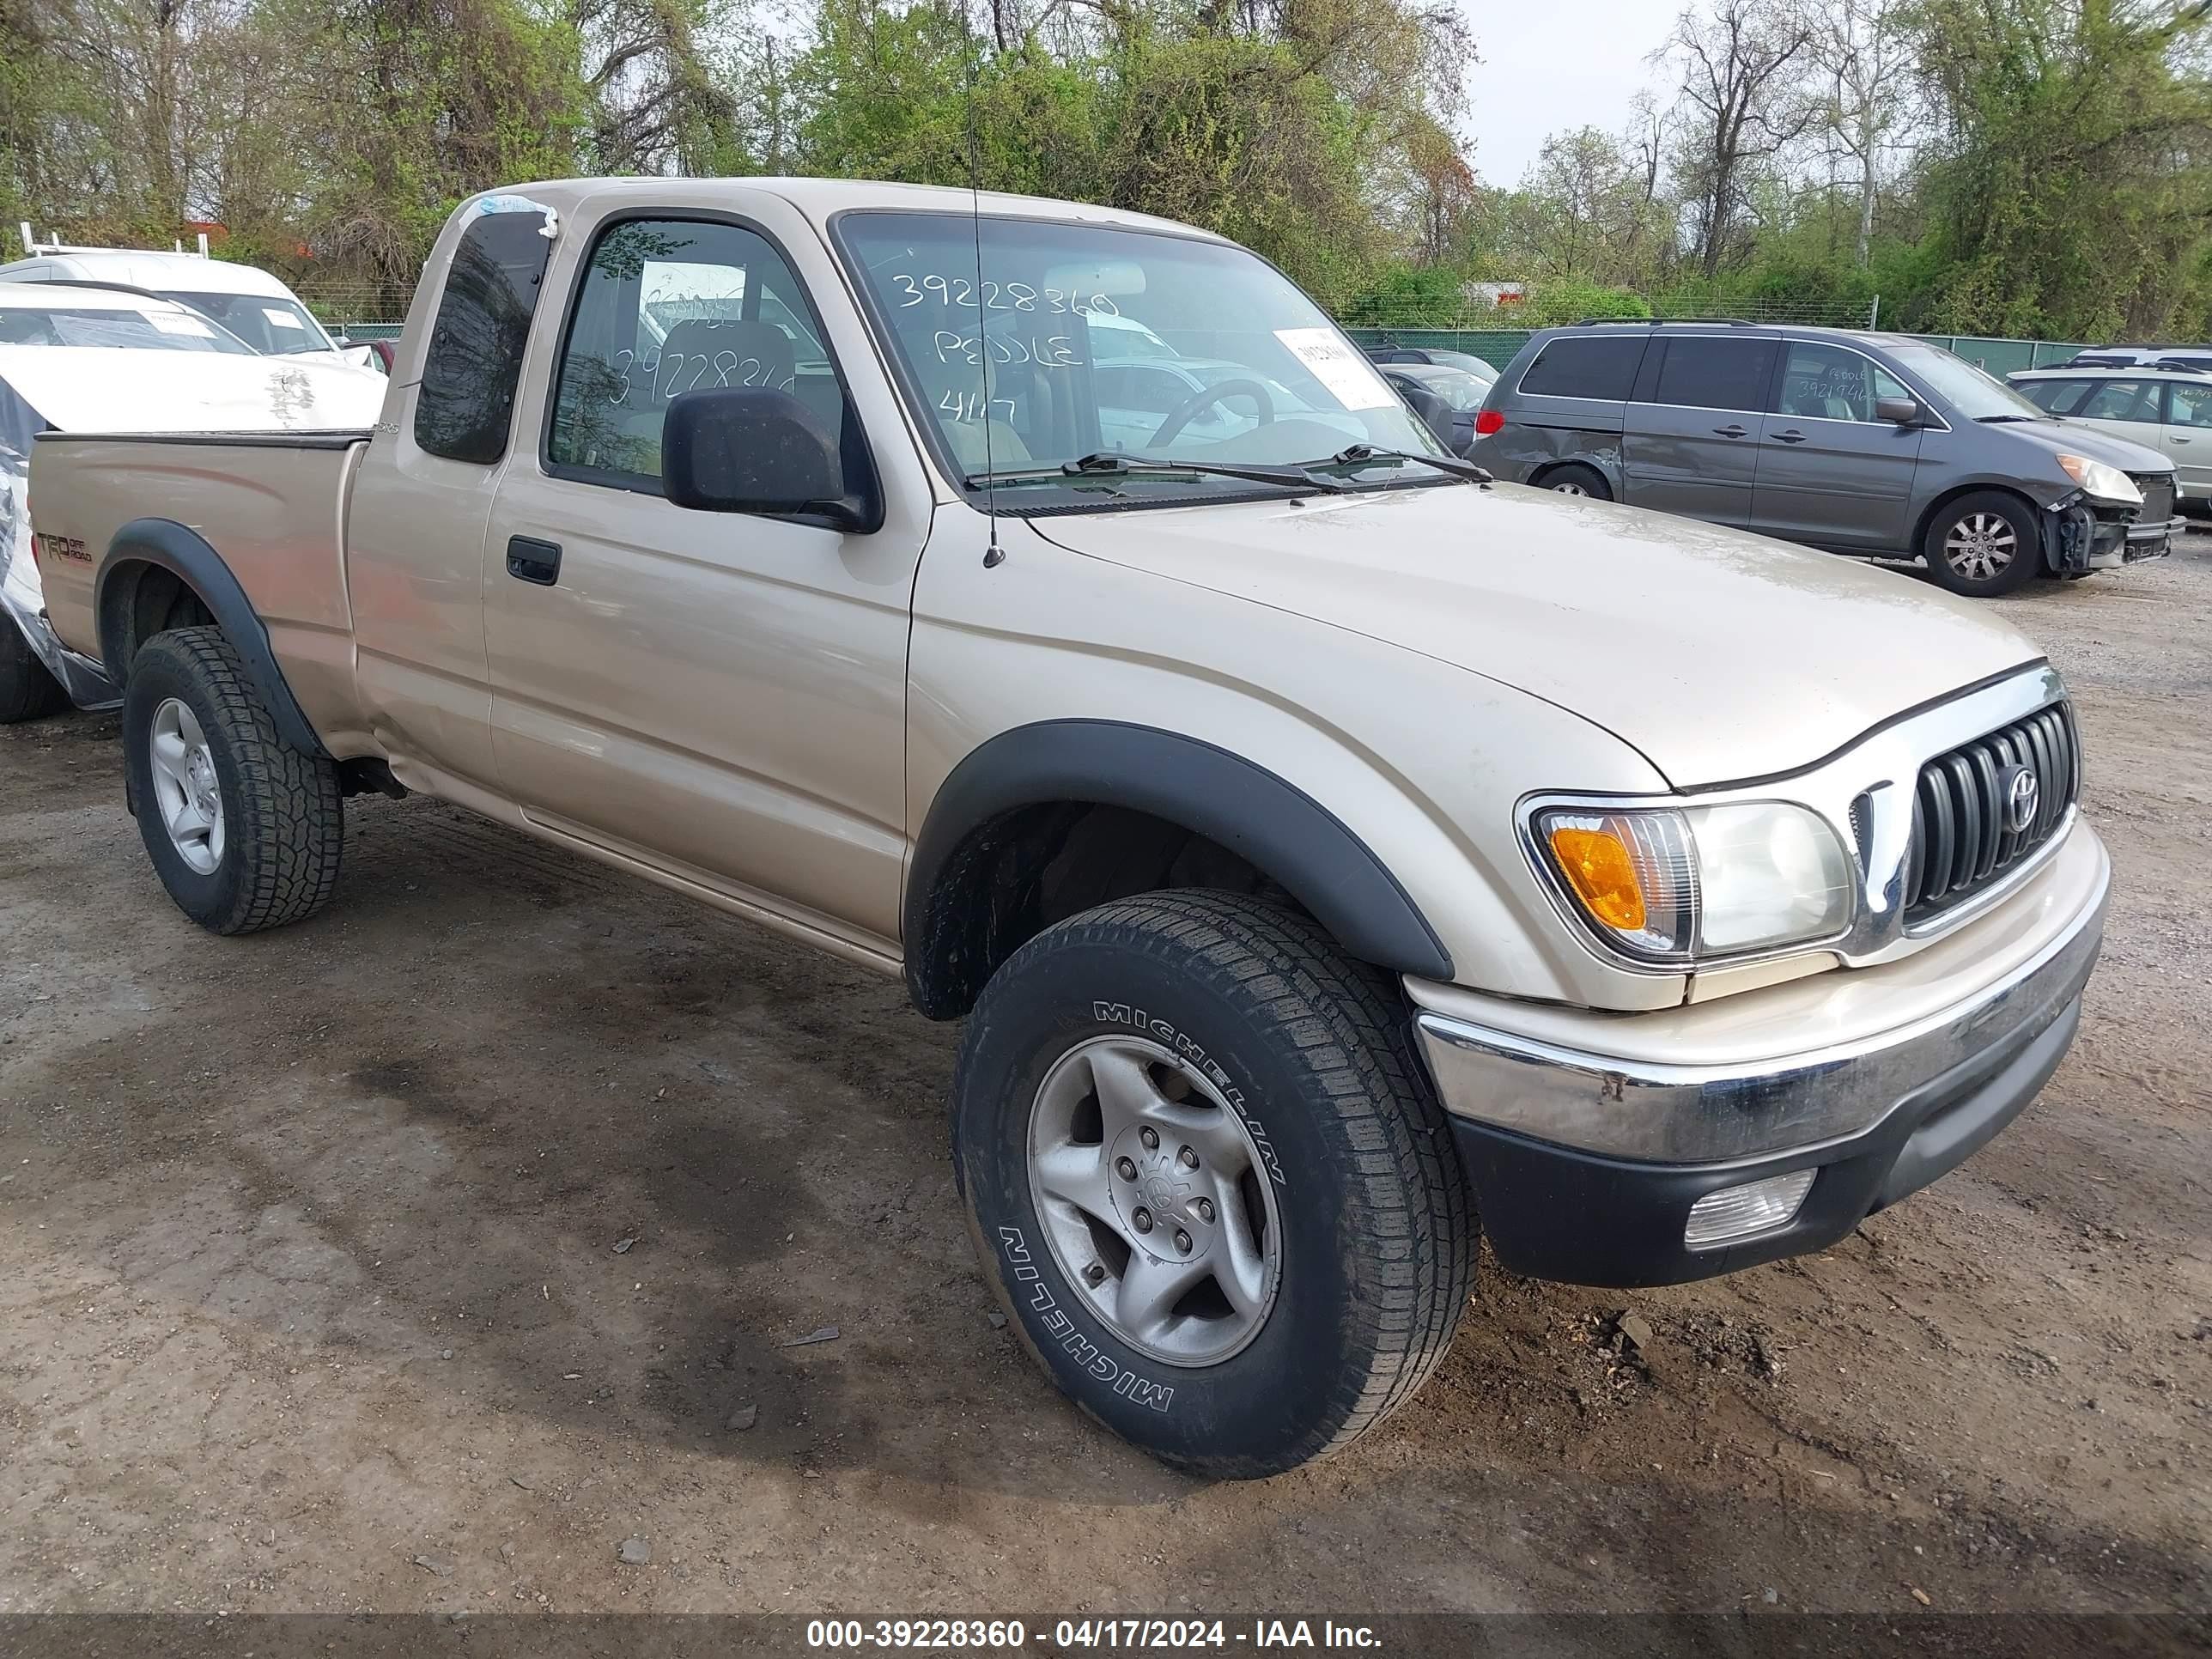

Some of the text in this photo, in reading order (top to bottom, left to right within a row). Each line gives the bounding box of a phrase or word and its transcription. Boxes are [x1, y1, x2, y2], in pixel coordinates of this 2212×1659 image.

[893, 275, 1120, 317] 39228360
[36, 532, 70, 562] TRD
[69, 538, 85, 550] OFF
[70, 550, 92, 562] ROAD
[1093, 1000, 1286, 1185] MICHELIN
[999, 1225, 1176, 1413] MICHELIN
